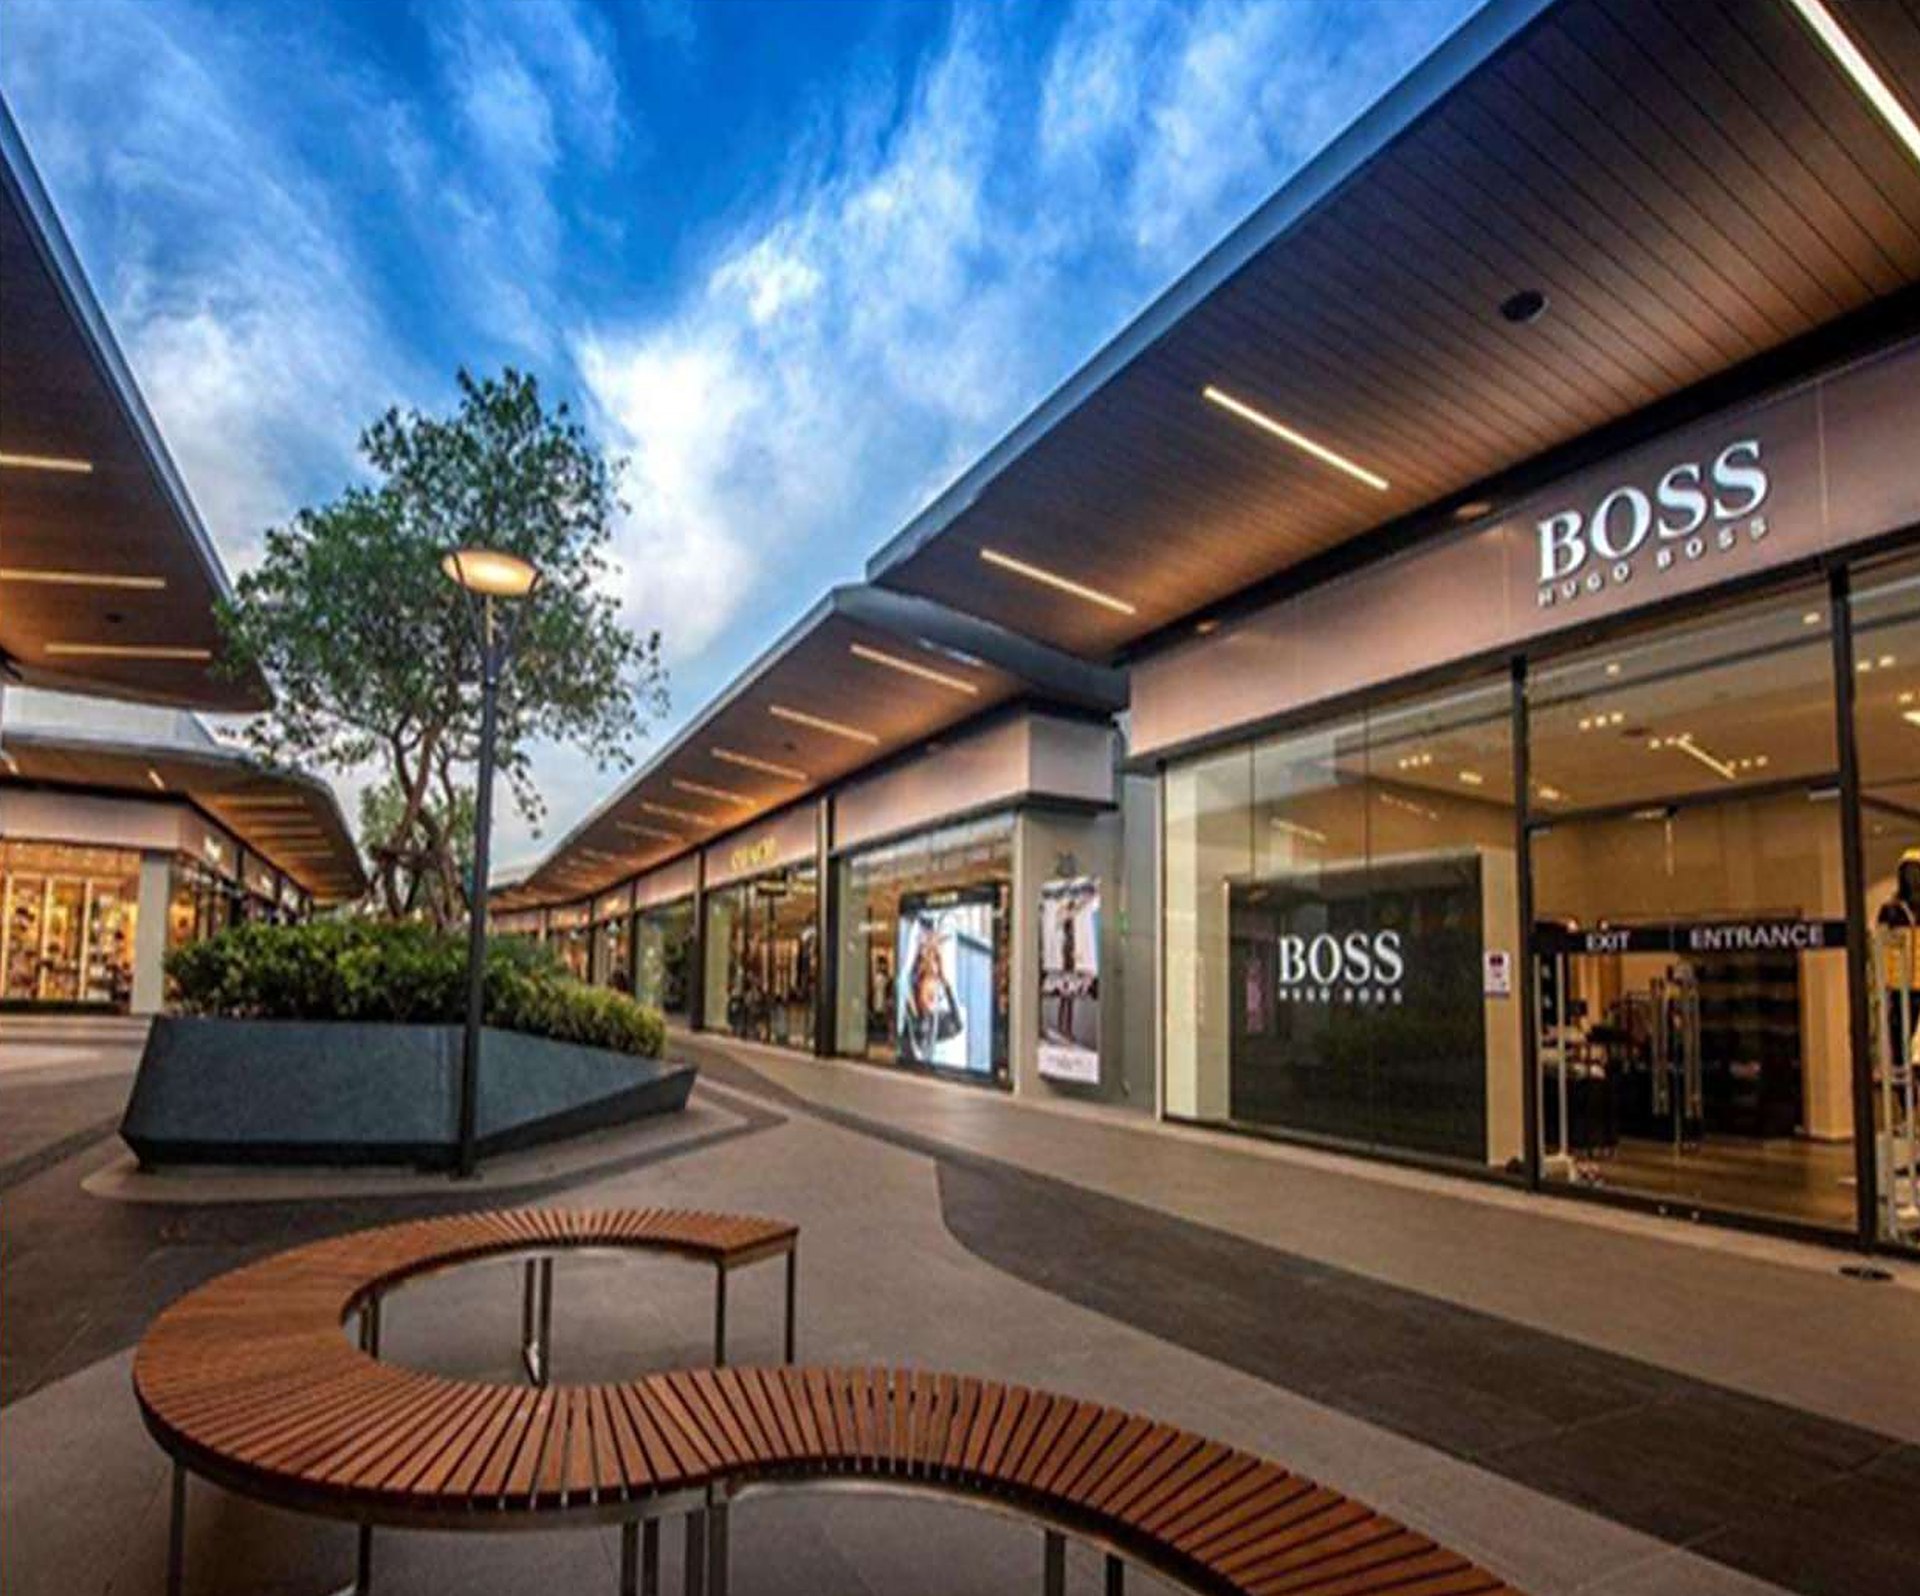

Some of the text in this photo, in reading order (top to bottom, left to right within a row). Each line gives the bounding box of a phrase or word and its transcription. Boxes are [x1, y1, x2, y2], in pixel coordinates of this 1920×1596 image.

[1537, 440, 1769, 582] BOSS
[1279, 929, 1404, 984] BOSS
[1586, 923, 1823, 950] EXIT ENTRANCE
